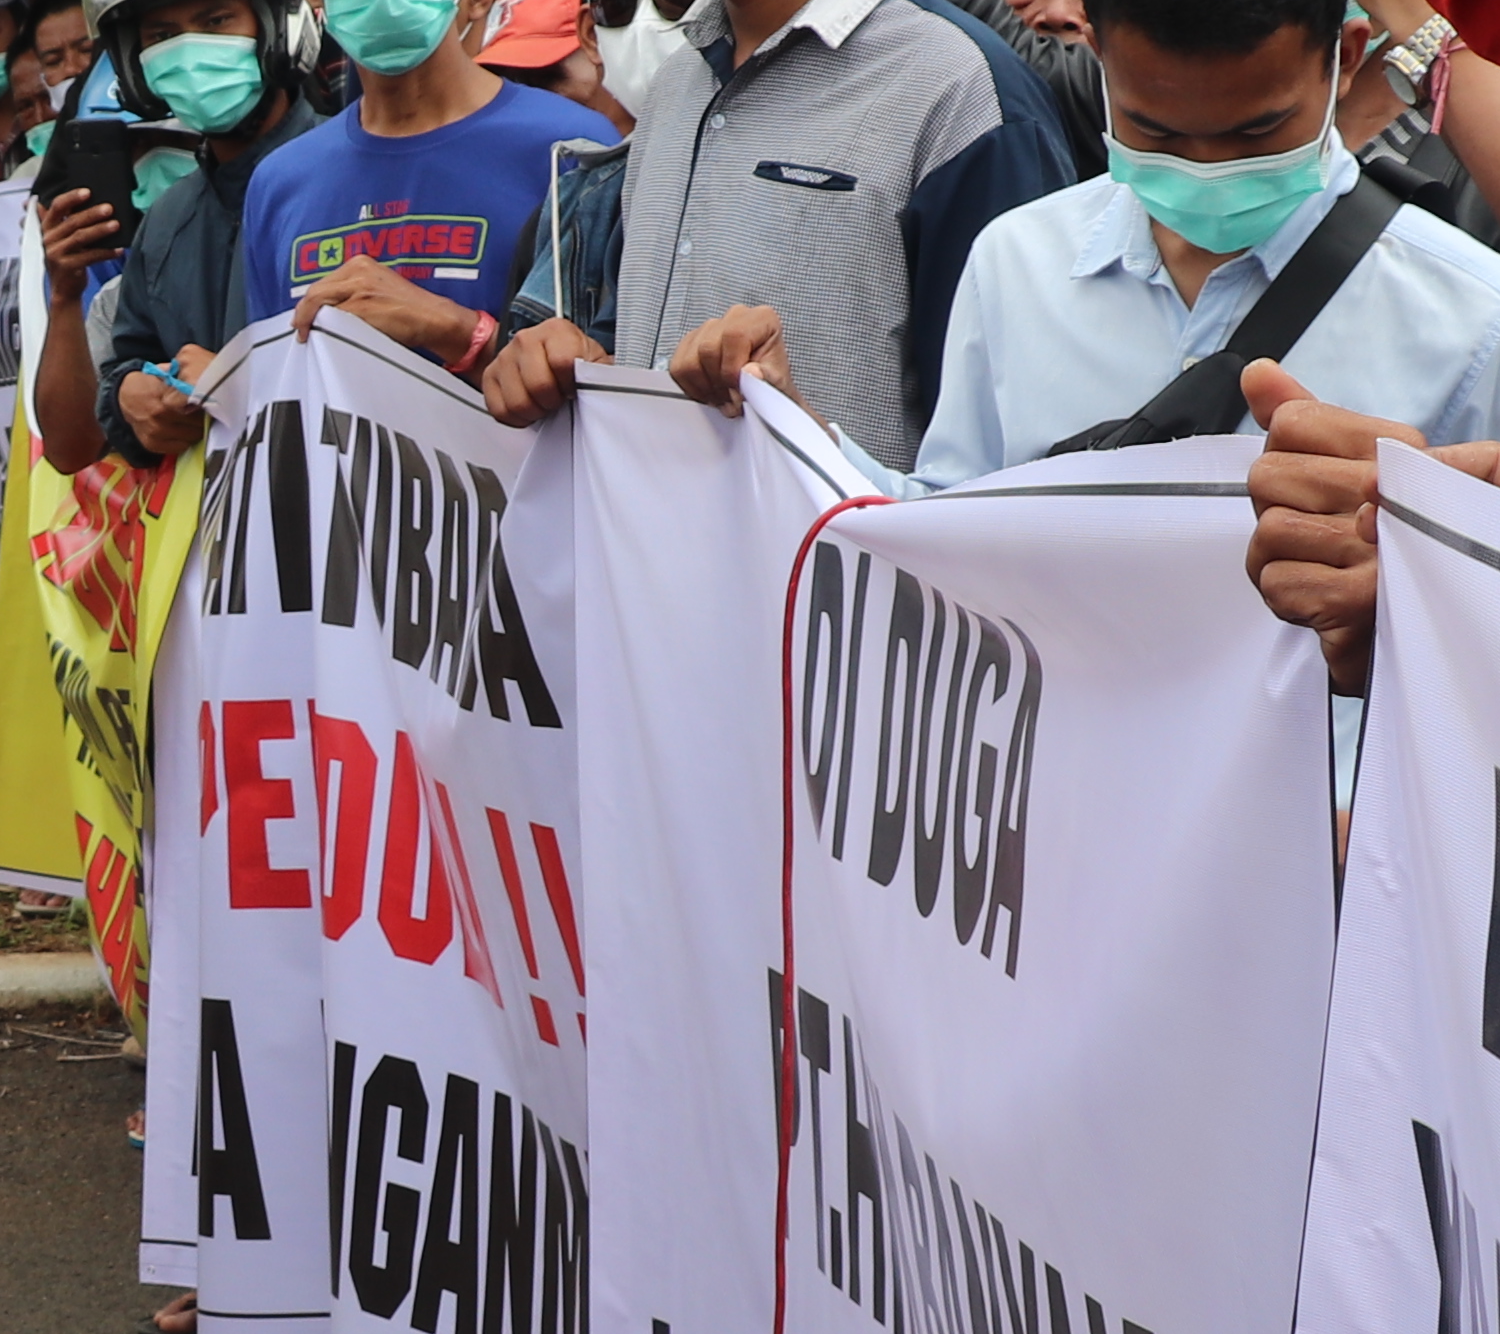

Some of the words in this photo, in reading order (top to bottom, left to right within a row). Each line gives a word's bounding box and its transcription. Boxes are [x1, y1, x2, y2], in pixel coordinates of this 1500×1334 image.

[359, 204, 381, 220] ALL
[802, 540, 872, 863] DI
[867, 567, 1043, 982] DUGA
